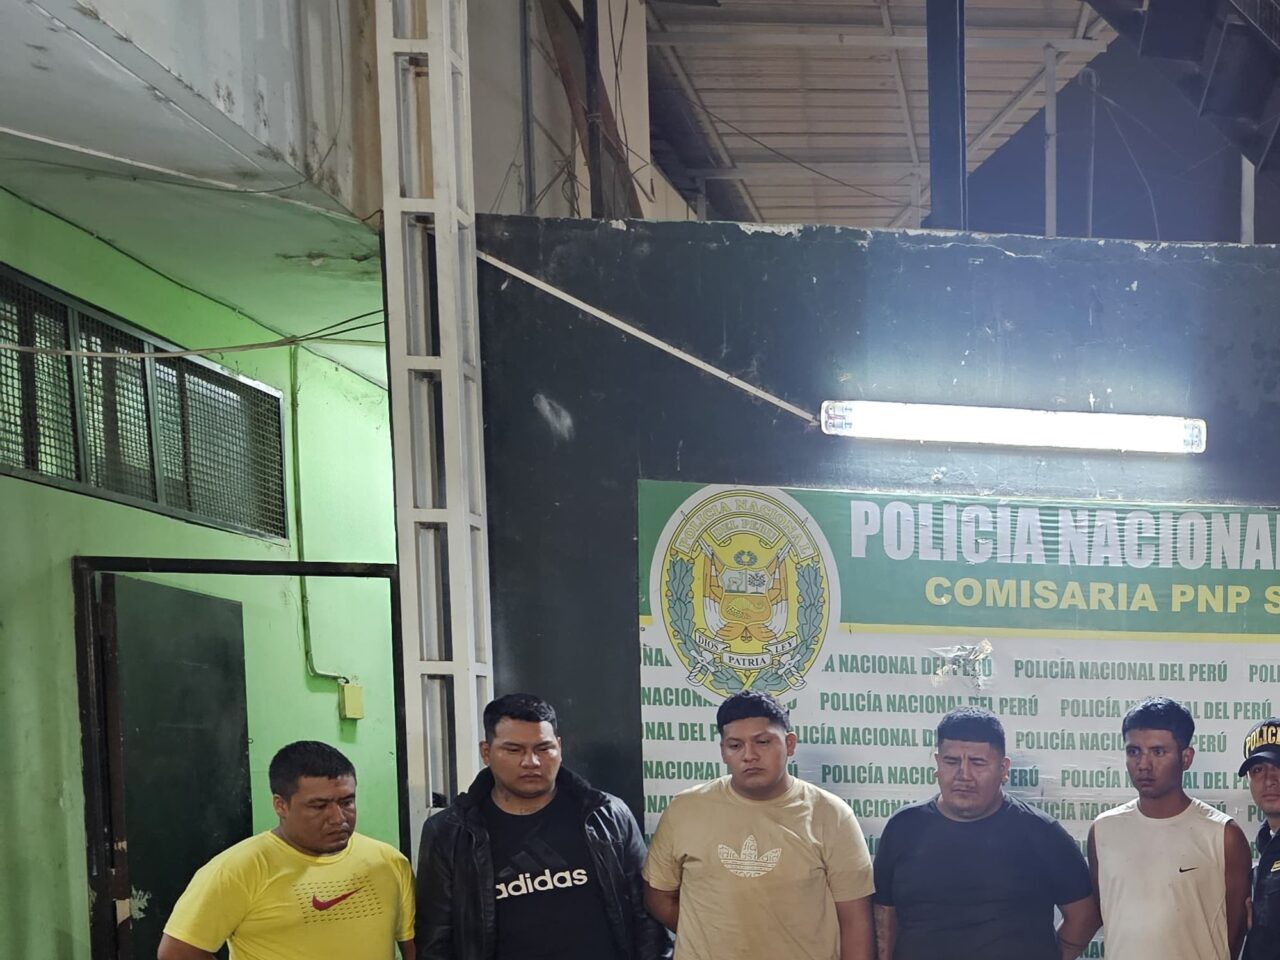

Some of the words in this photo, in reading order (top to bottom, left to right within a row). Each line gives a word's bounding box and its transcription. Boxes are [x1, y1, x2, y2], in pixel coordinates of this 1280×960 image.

[735, 499, 811, 555] NACIONAL
[850, 499, 1047, 565] POLICÍA
[925, 576, 1158, 613] COMISARIA
[1171, 584, 1250, 613] PNP
[697, 636, 720, 652] DIOS
[775, 640, 793, 653] LEY
[728, 656, 767, 667] PATRIA
[839, 655, 917, 675] NACIONAL
[1014, 658, 1076, 679] POLICÍA
[1079, 661, 1156, 681] NACIONAL
[1159, 663, 1185, 681] DEL
[1189, 660, 1228, 682] PERÚ
[820, 690, 883, 712] POLICÍA
[1000, 694, 1039, 716] PERÚ
[1060, 697, 1121, 717] POLICÍA
[1204, 701, 1230, 720] DEL
[1233, 699, 1272, 720] PERÚ
[678, 722, 706, 742] DEL
[841, 726, 918, 747] NACIONAL
[1015, 729, 1076, 750] POLICÍA
[821, 762, 884, 785] POLICÍA
[1009, 765, 1040, 787] ERÚ
[1061, 767, 1121, 788] POLICÍA
[1203, 771, 1229, 789] DEL
[496, 867, 588, 900] adidas
